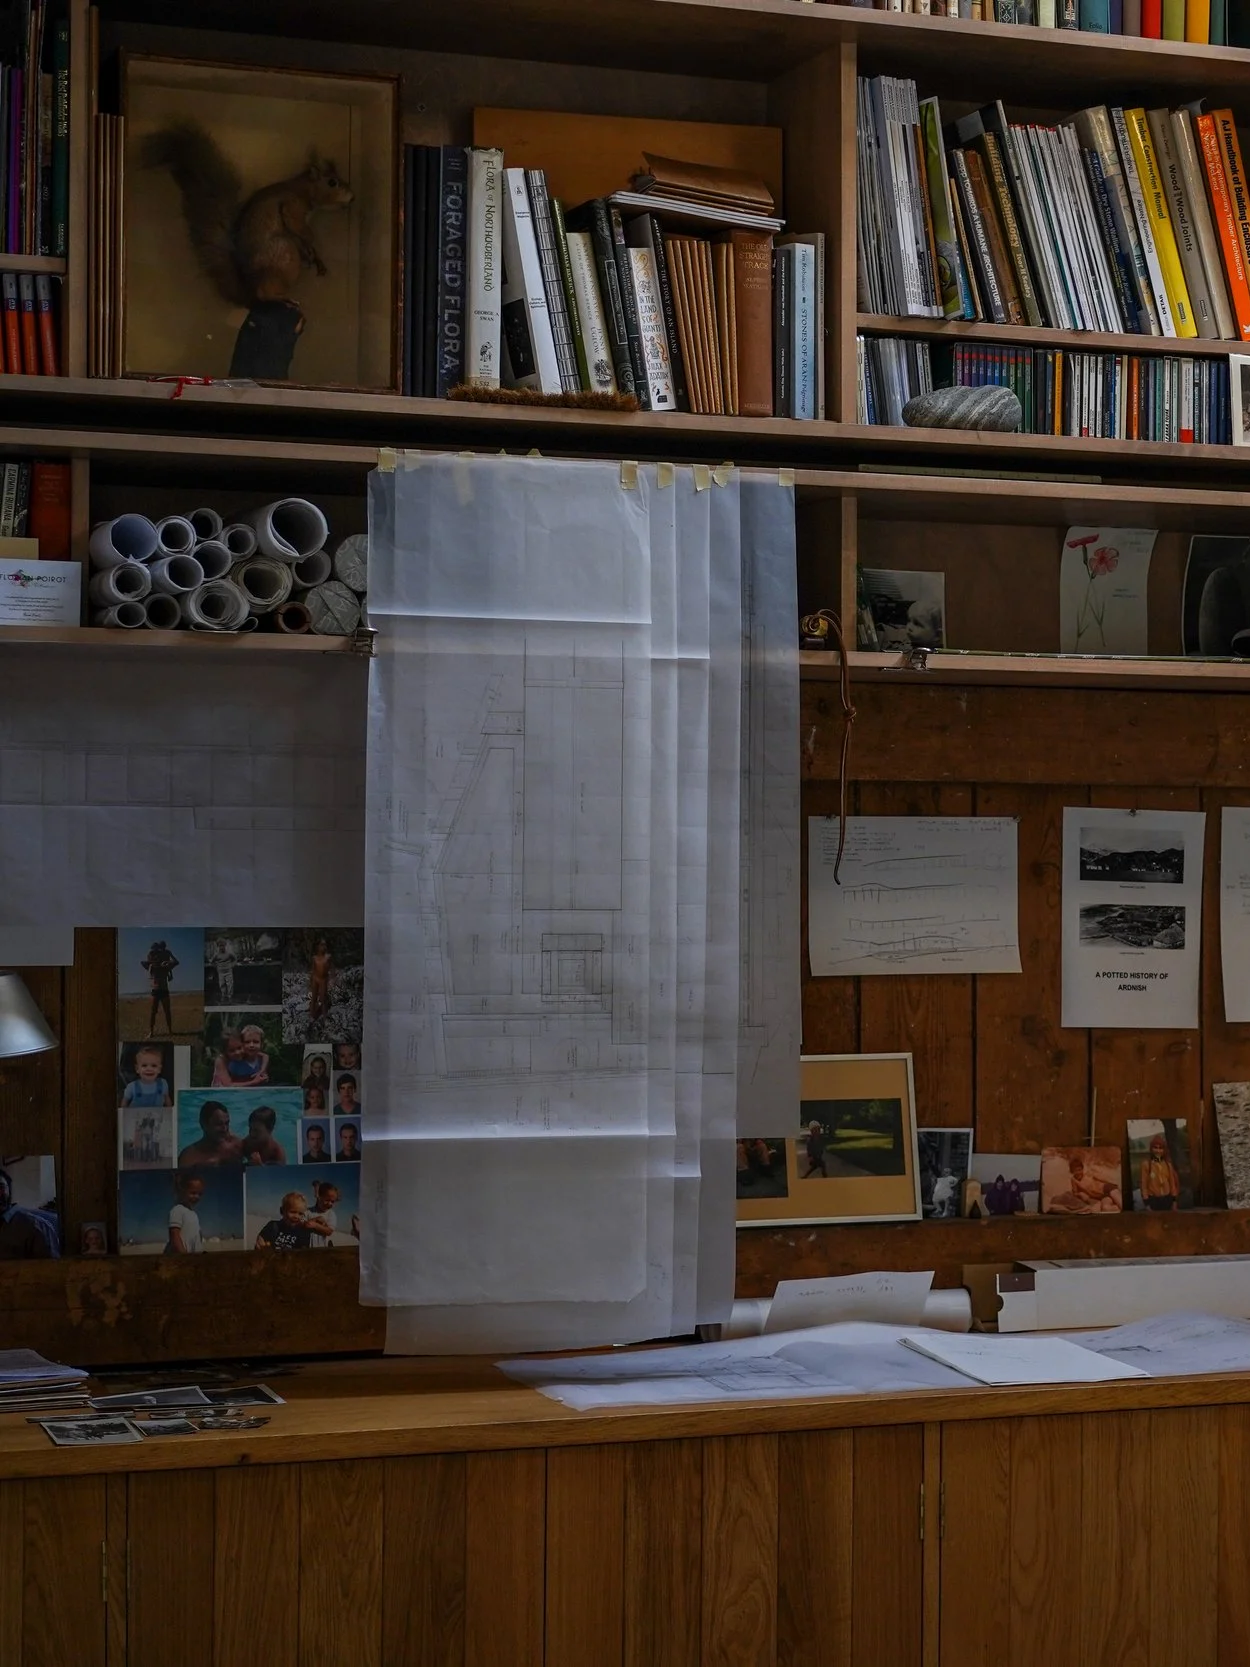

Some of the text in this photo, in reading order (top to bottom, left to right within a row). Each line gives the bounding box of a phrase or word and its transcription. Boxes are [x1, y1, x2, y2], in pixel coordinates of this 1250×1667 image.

[57, 69, 67, 79] The
[1220, 118, 1231, 132] AJ
[1123, 149, 1134, 174] TIMBER
[1136, 116, 1166, 219] Timber Construction Manual
[1222, 132, 1240, 176] Handbook
[983, 133, 1021, 249] Building Technology
[1207, 161, 1220, 190] McLeod
[1214, 162, 1230, 212] Contemporary
[1231, 175, 1242, 186] of
[1103, 206, 1114, 228] Stone
[1167, 163, 1193, 252] Wood Wood Joints
[1232, 185, 1248, 221] Building
[482, 159, 496, 291] FLORA NORTHUMBERLAND
[962, 177, 1001, 306] TOWARDS A HUMANE ARCHITECTURE
[1135, 198, 1154, 254] Engineering Nature
[1225, 212, 1236, 238] Timber
[442, 181, 463, 367] FORAGED FLORA
[1015, 252, 1025, 268] Ivor
[1020, 274, 1033, 299] Seeley
[1230, 237, 1245, 280] Architecture
[640, 305, 657, 314] LAND
[659, 268, 678, 354] THE STORY OF AN ISLAND
[589, 326, 600, 355] UGLOW
[596, 328, 605, 351] JENNY
[800, 344, 807, 355] OF
[2, 467, 17, 521] CARMINA BURANA
[36, 574, 67, 583] POIROT
[1102, 971, 1128, 979] POTTED
